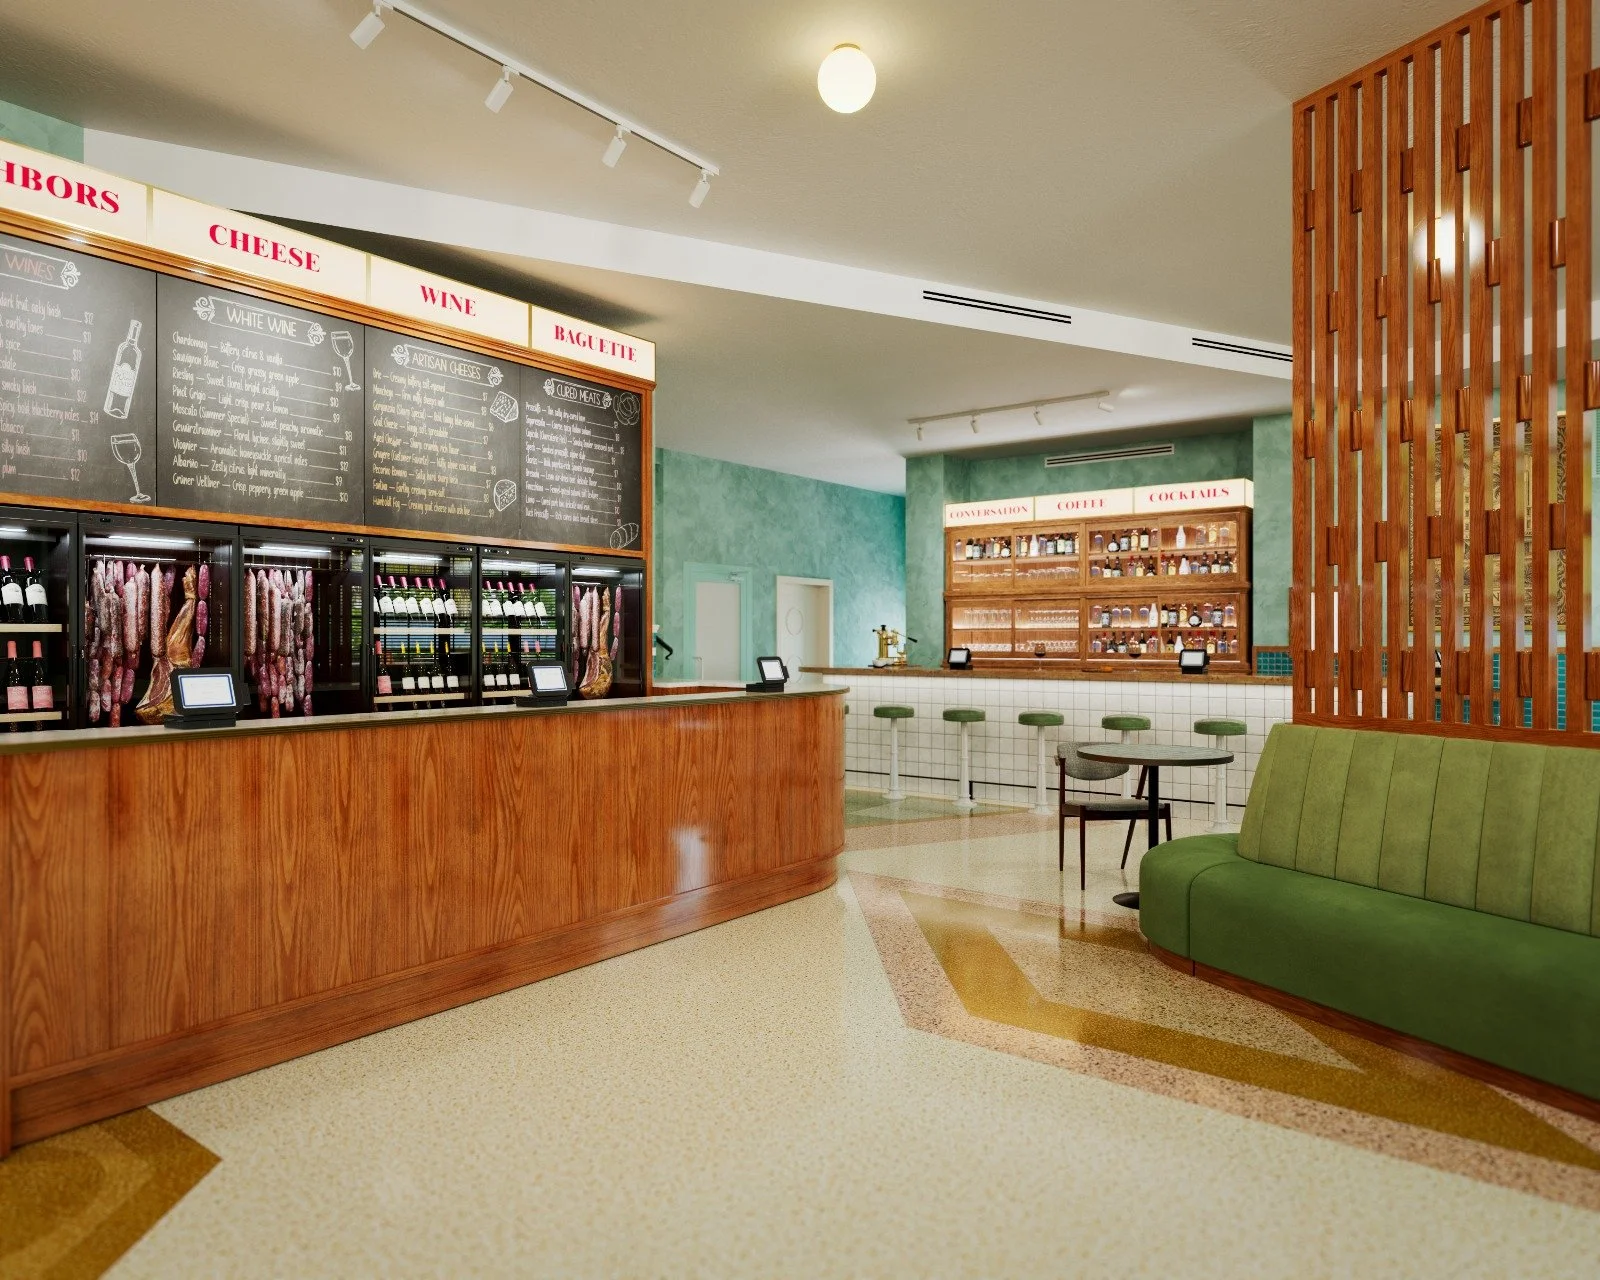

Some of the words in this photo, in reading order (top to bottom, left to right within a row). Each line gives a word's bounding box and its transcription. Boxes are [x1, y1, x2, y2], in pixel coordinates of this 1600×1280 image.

[209, 224, 320, 273] CHEESE
[5, 252, 55, 281] WINES
[419, 285, 477, 317] WINE
[227, 306, 263, 329] WHITE
[268, 317, 297, 337] WINE
[5, 339, 21, 355] spice
[172, 331, 208, 354] Chardonnay
[260, 350, 264, 361] &
[554, 325, 637, 362] BAGUETTE
[172, 349, 202, 369] Sauvignon
[203, 355, 220, 369] Blanc
[412, 353, 447, 372] ARTISAN
[450, 361, 481, 380] CHEESES
[172, 367, 194, 386] Riesling
[1, 378, 21, 398] smoky
[172, 384, 188, 398] Pinot
[189, 387, 206, 405] Grigio
[266, 400, 271, 412] &
[556, 384, 577, 400] CURED
[579, 390, 601, 406] MEATS
[172, 402, 197, 416] Moscato
[199, 406, 226, 421] (Summer
[172, 437, 198, 455] Viognier
[2, 460, 17, 478] plum
[211, 459, 228, 477] Zesty
[273, 487, 289, 500] green
[1149, 488, 1230, 502] COCKTAILS
[950, 505, 1029, 519] CONVERSATION
[1057, 498, 1107, 511] COFFEE
